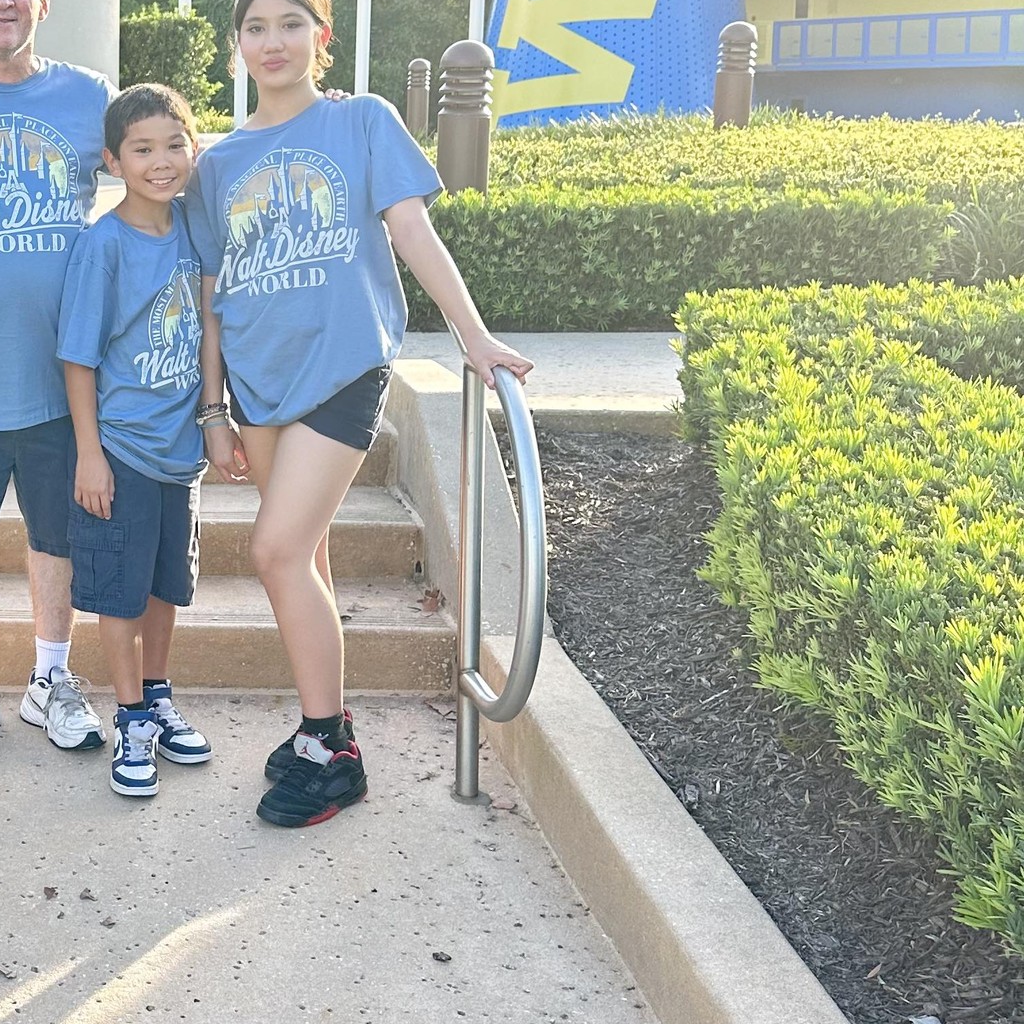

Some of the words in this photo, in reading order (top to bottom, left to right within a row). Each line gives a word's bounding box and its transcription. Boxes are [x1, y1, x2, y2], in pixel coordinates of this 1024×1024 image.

[25, 119, 57, 143] PLACE
[58, 141, 72, 155] ON
[293, 152, 325, 166] PLACE
[323, 166, 338, 180] ON
[333, 182, 346, 222] EARTH
[265, 224, 360, 268] Disney
[248, 267, 326, 297] WORLD
[153, 296, 167, 323] MOST
[134, 341, 191, 385] Walt
